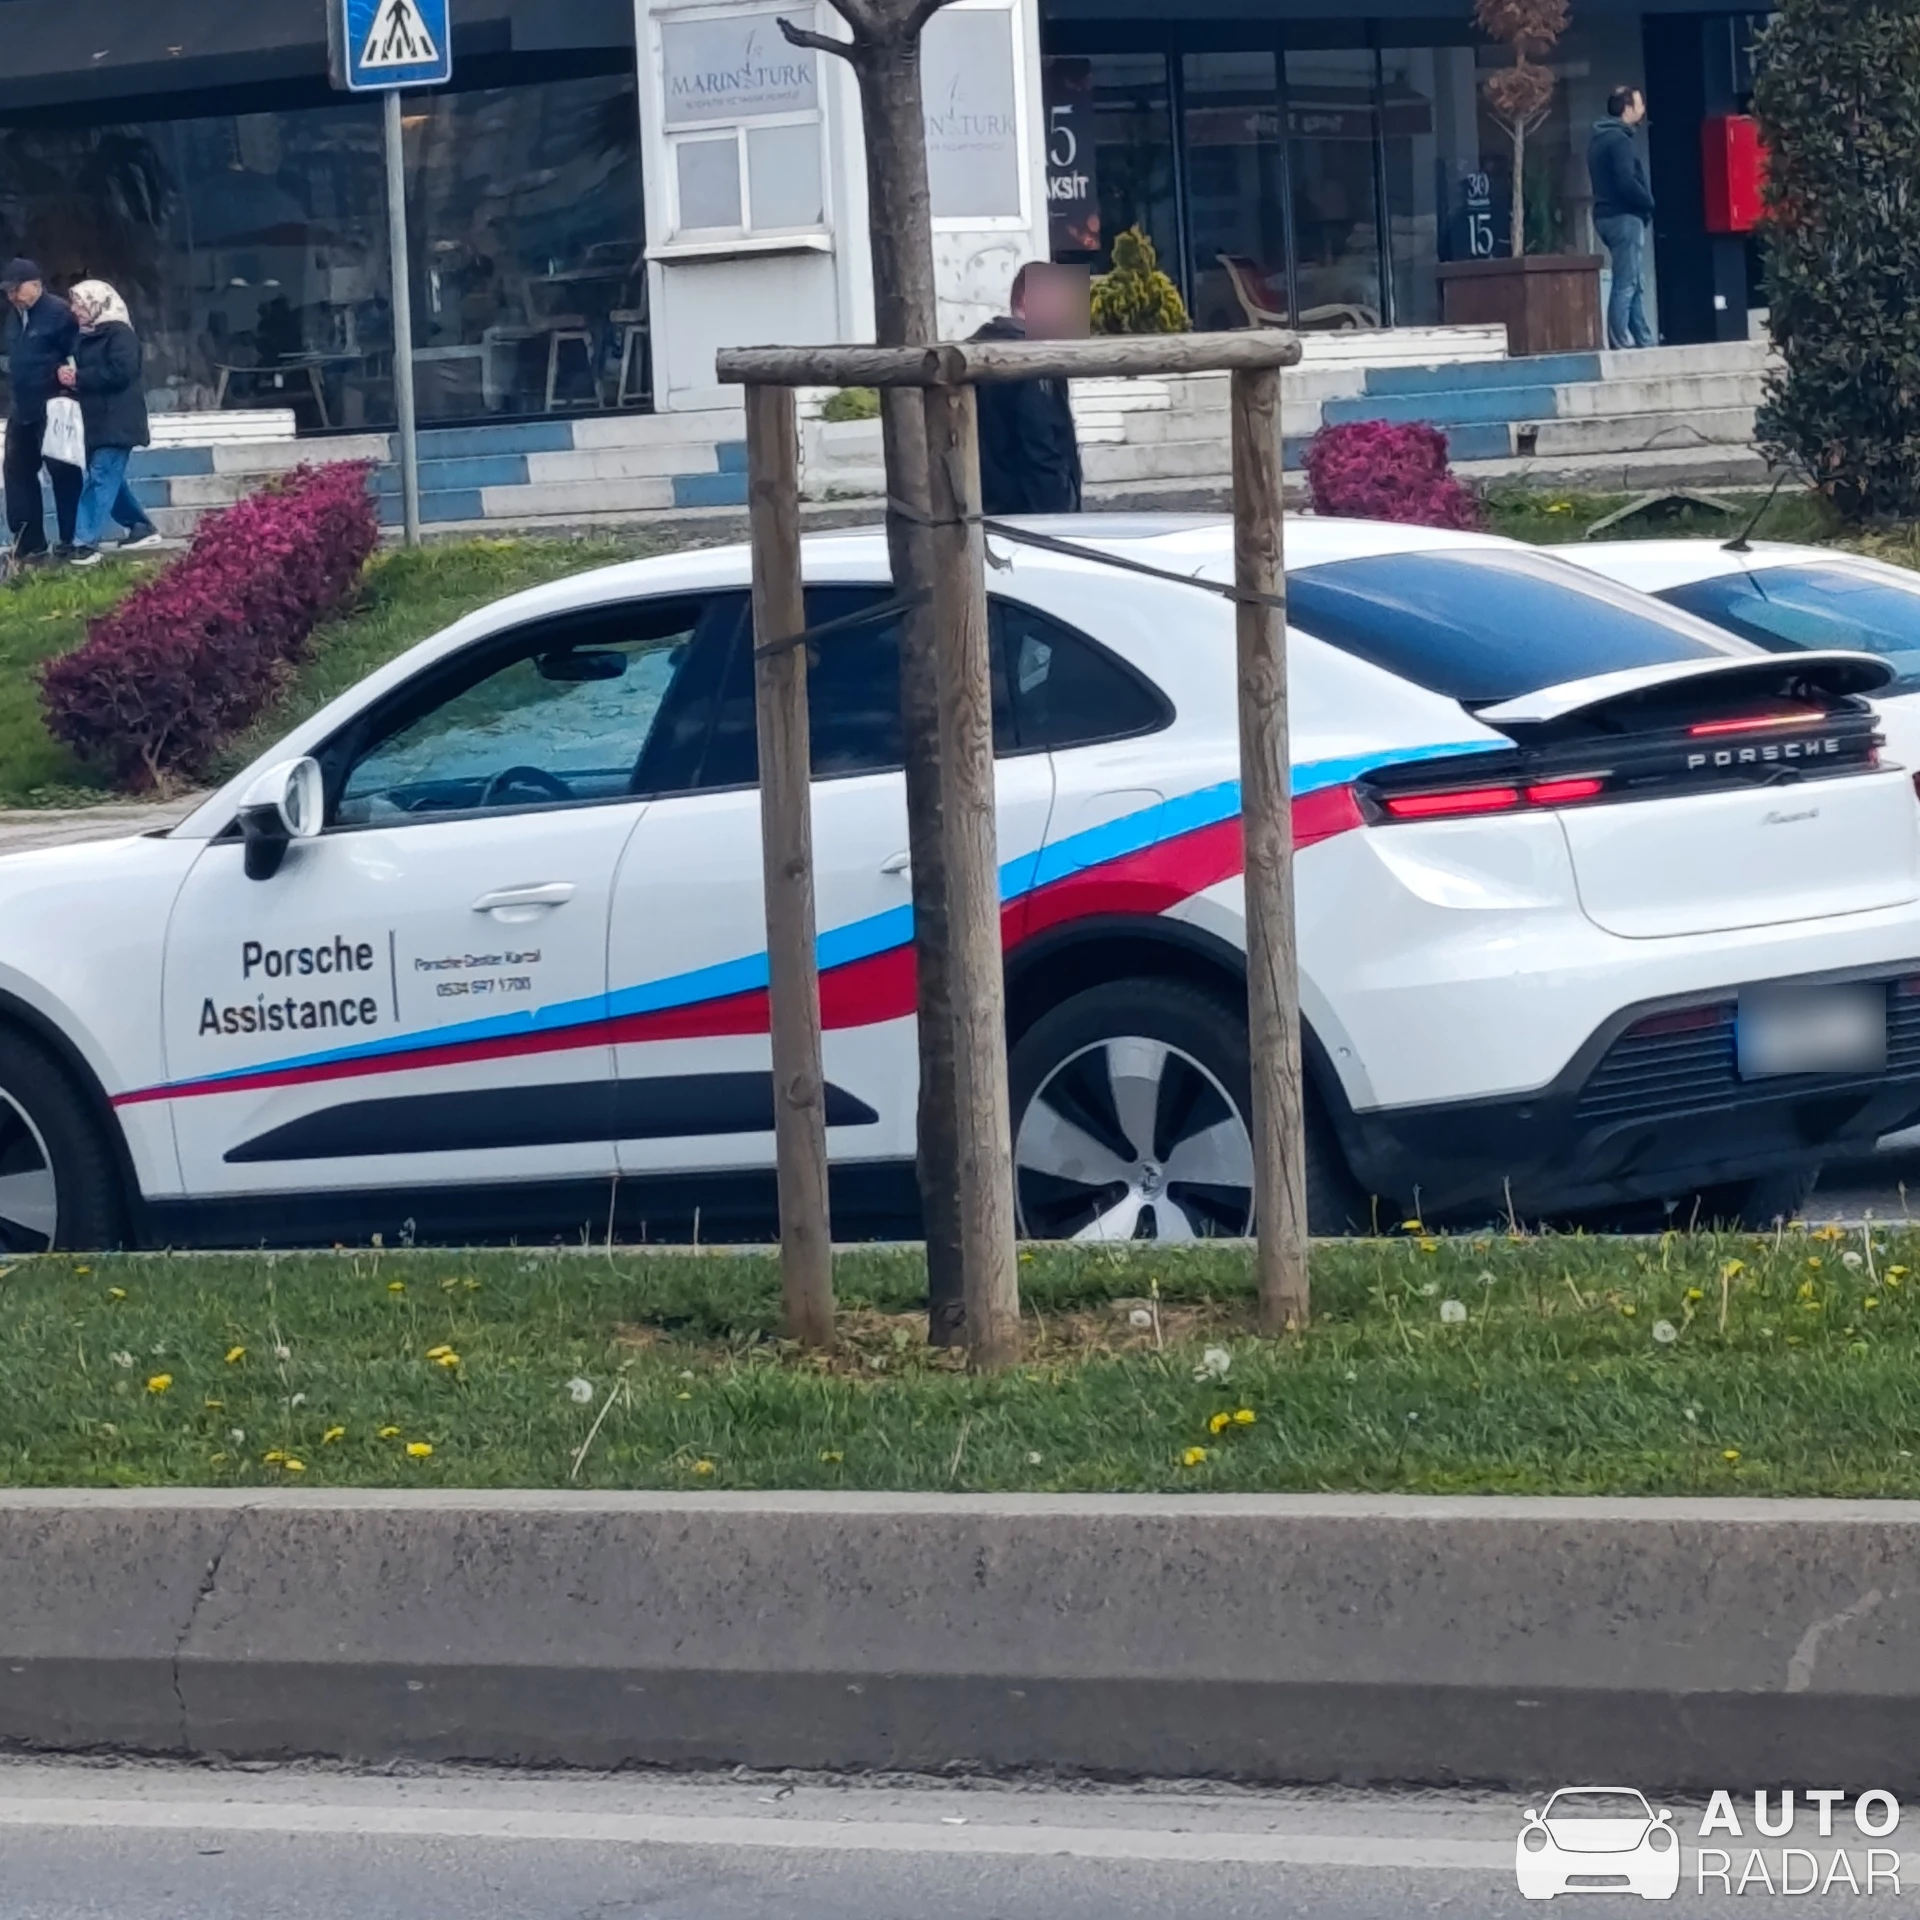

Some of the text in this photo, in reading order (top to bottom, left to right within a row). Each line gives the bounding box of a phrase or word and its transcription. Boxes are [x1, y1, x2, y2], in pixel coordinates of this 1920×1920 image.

[1468, 213, 1494, 256] 15
[1688, 738, 1840, 770] PORSCHE
[243, 934, 374, 979] Porsche
[199, 993, 378, 1036] Assistance
